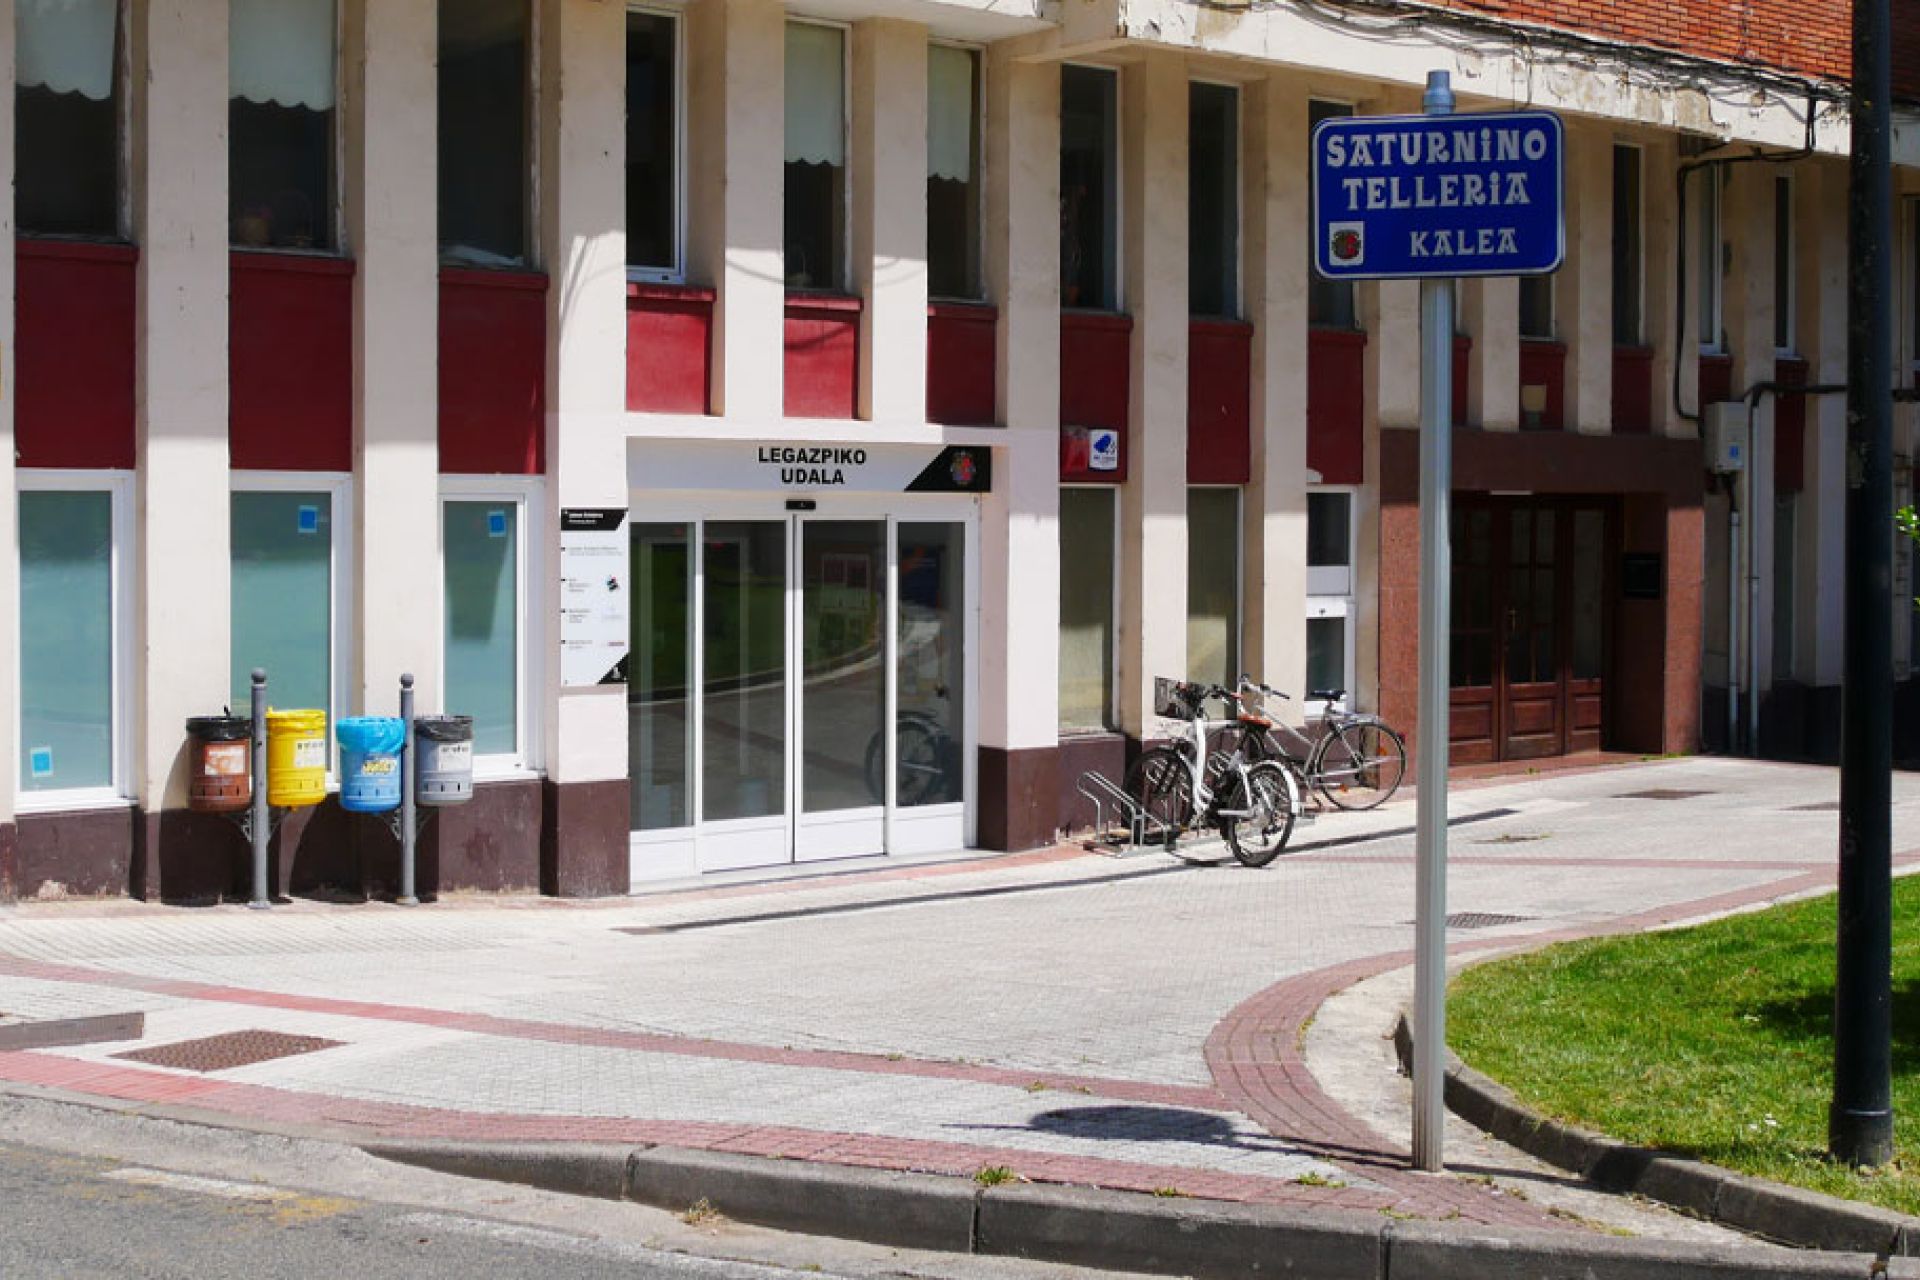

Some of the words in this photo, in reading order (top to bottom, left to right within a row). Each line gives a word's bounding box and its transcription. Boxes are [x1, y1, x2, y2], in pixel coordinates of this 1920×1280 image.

[1409, 227, 1518, 257] KALEA
[758, 447, 867, 464] LEGAZPIKO
[781, 468, 845, 485] UDALA
